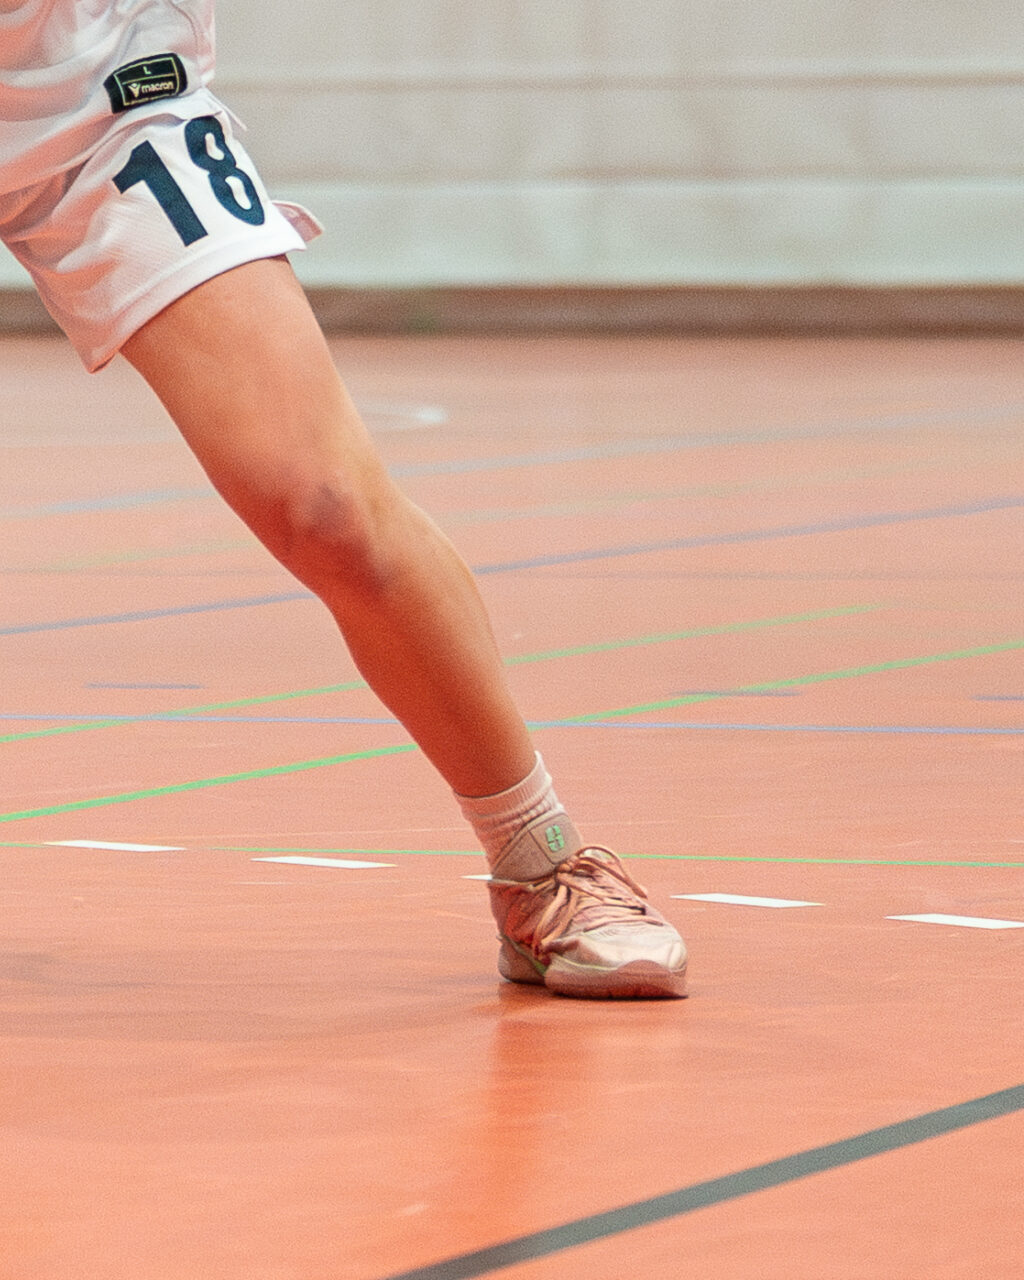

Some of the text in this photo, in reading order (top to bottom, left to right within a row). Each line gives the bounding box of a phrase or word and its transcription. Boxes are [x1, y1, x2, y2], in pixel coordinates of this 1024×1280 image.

[143, 66, 152, 75] L
[141, 81, 174, 94] macron
[112, 115, 265, 247] 18
